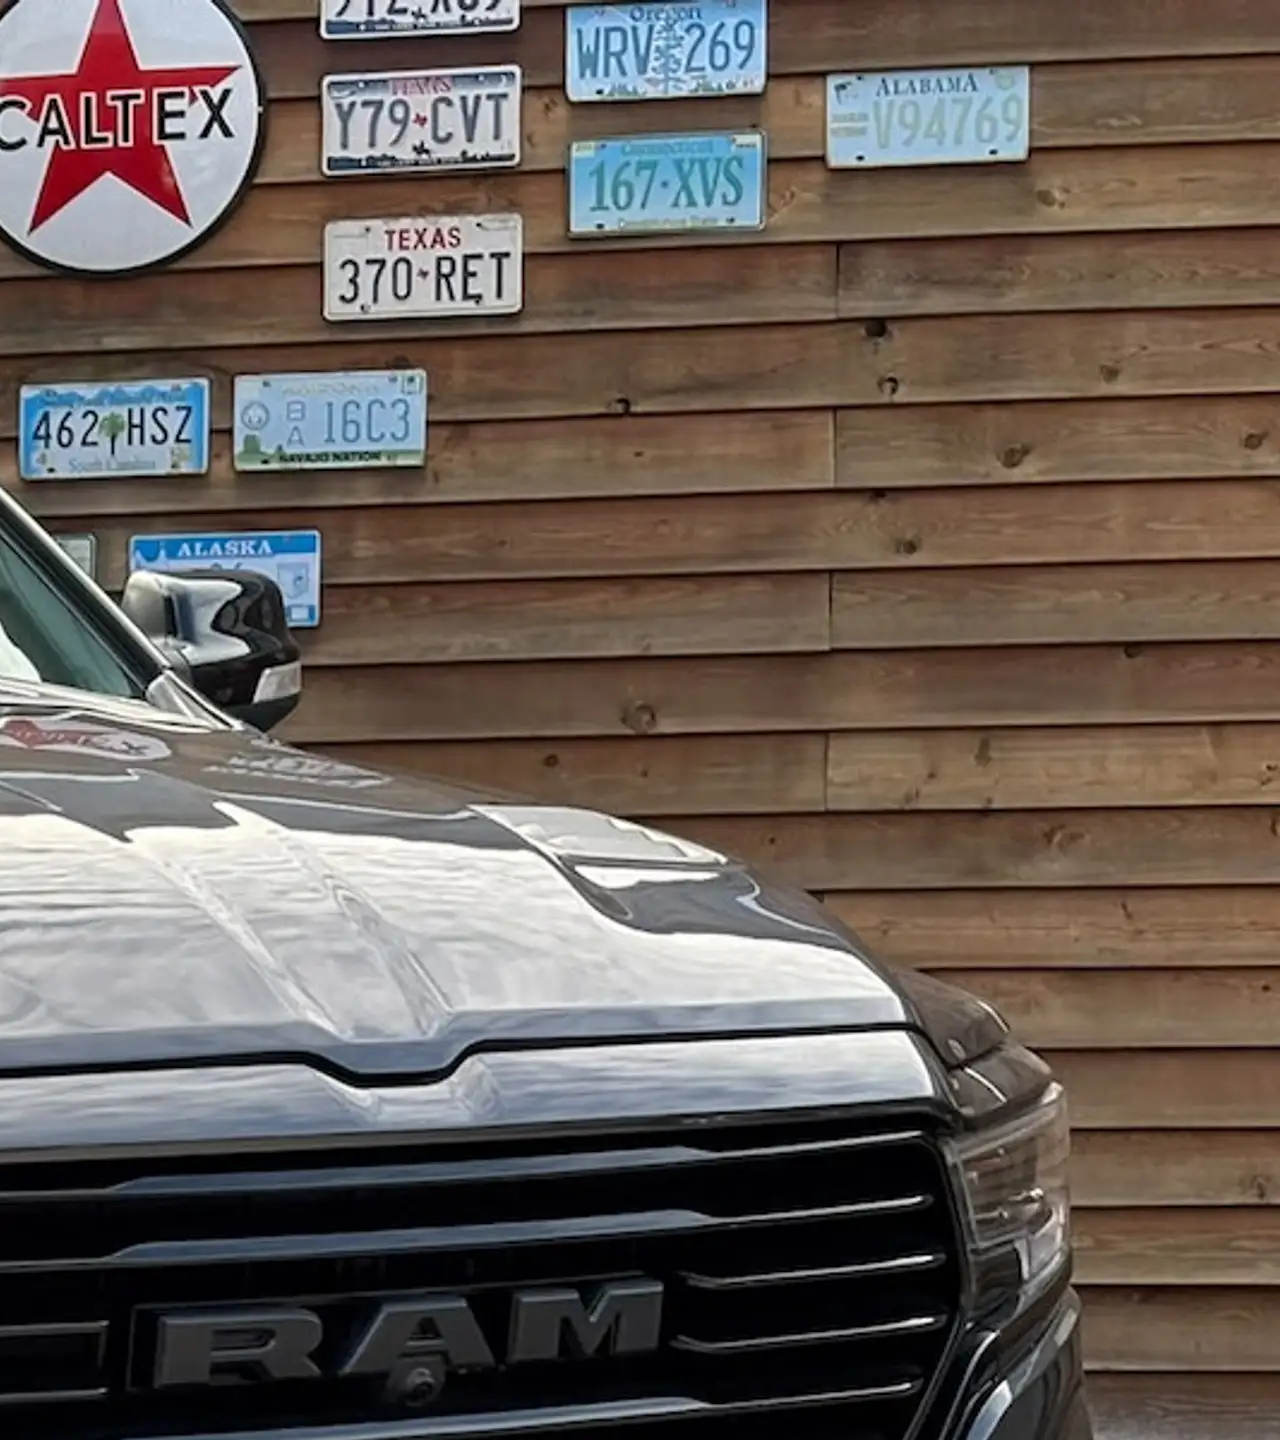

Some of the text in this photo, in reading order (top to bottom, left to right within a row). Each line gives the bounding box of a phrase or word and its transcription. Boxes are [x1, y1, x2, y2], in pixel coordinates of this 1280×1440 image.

[575, 18, 757, 80] WRV 269
[875, 71, 980, 98] ALABAMA
[334, 92, 510, 150] Y79 CVT
[872, 92, 1025, 150] V94769
[384, 227, 462, 251] TEXAS
[339, 251, 512, 305] 370 RET
[32, 405, 194, 450] 462 HSZ
[333, 450, 384, 463] NATION
[176, 539, 274, 558] ALASKA
[152, 1279, 666, 1392] RAM
